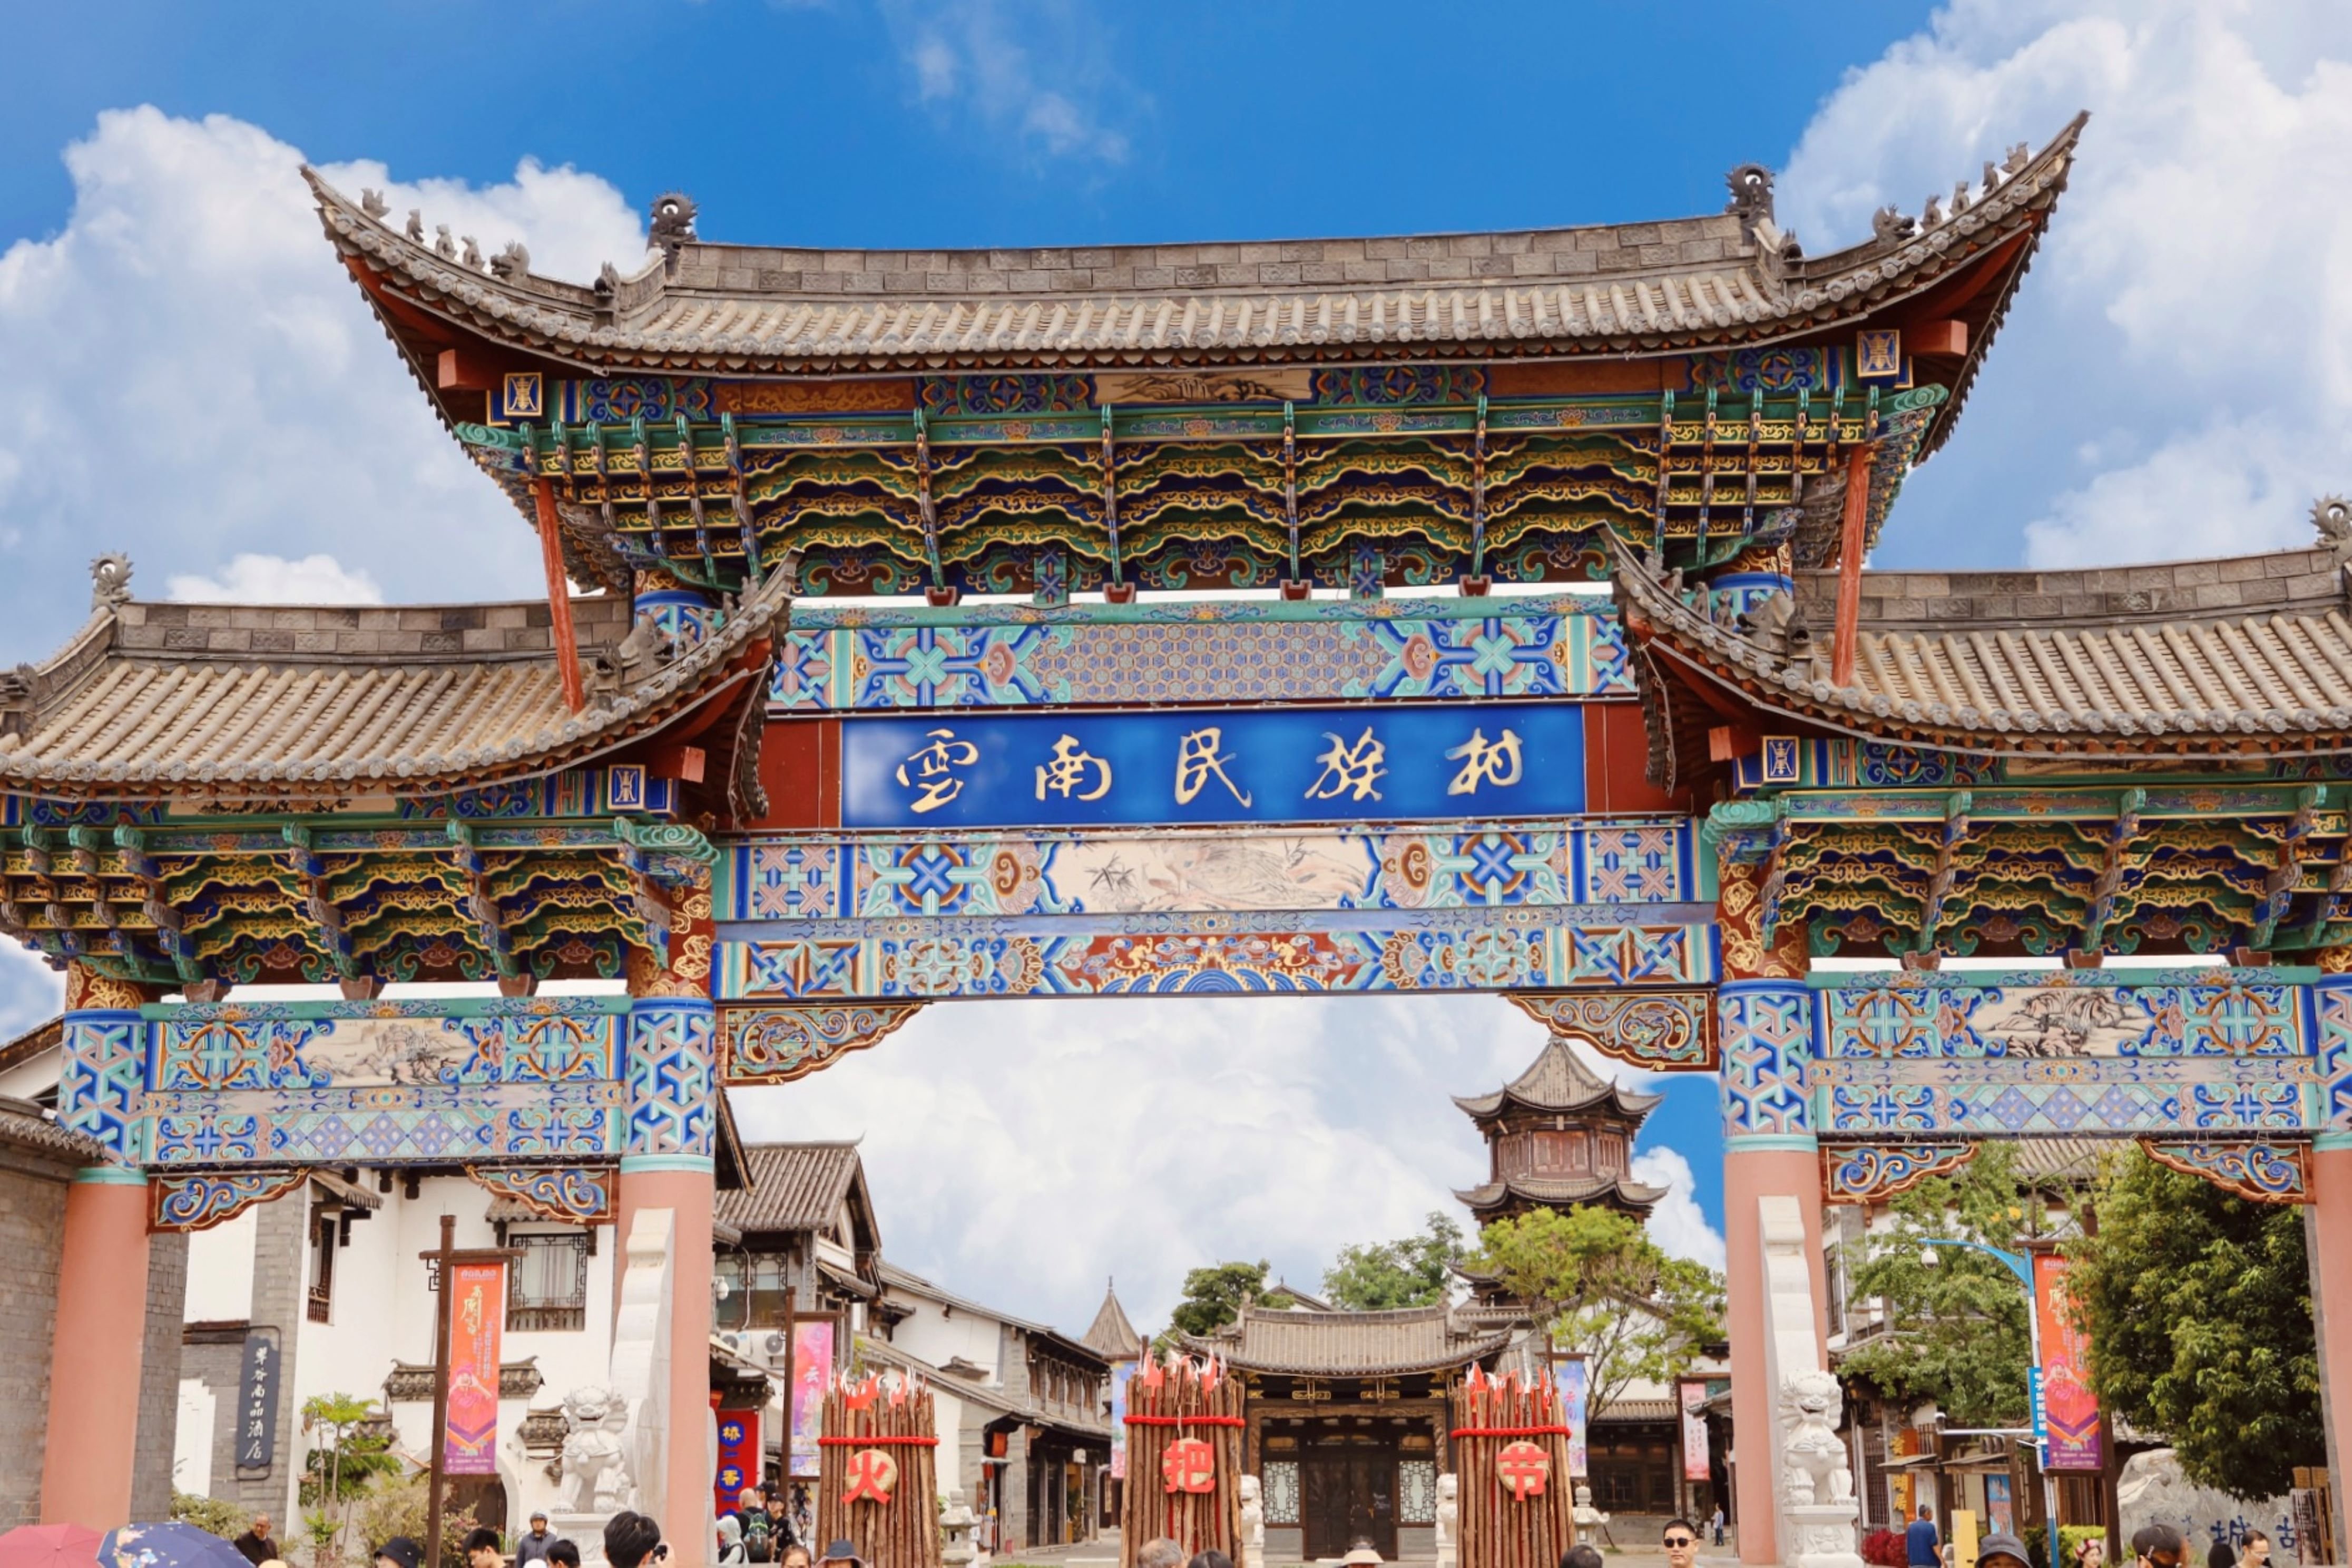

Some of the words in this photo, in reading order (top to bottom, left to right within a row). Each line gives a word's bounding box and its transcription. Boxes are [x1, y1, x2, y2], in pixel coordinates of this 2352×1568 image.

[840, 1452, 891, 1505] 火
[1163, 1439, 1216, 1493] 把
[1497, 1446, 1550, 1501] 节
